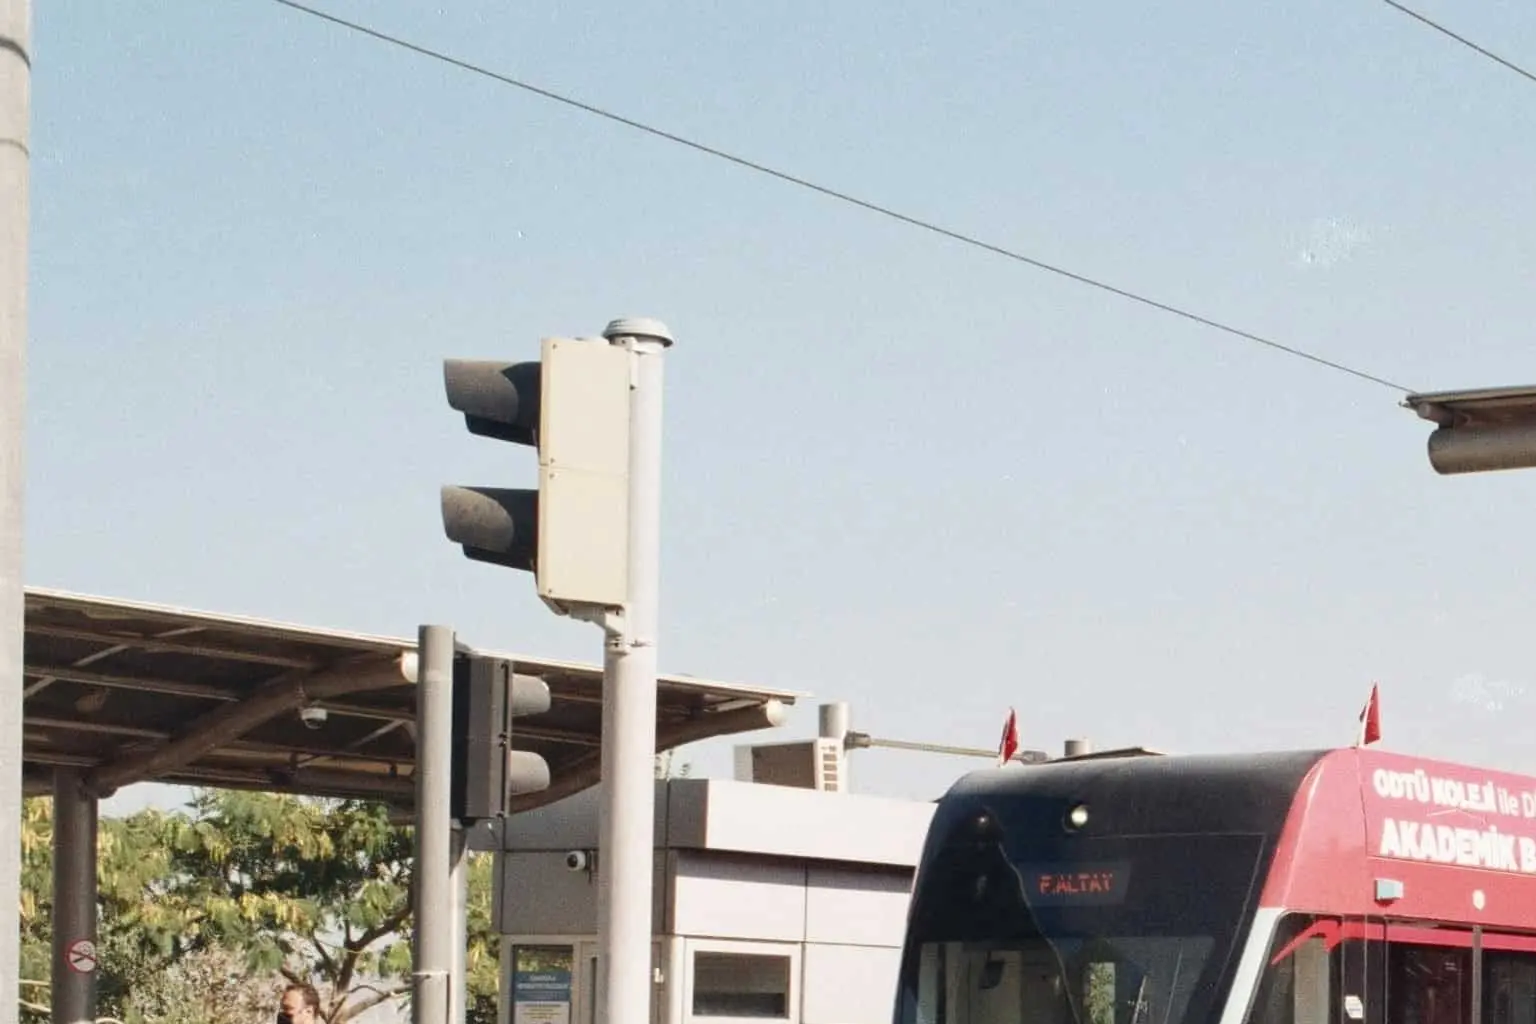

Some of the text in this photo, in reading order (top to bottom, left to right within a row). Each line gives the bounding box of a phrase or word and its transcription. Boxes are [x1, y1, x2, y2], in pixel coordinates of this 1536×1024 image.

[1373, 769, 1430, 803] ODTÜ
[1430, 776, 1498, 813] KOLEJİ
[1497, 786, 1519, 817] ile
[1379, 817, 1519, 872] AKADEMİK
